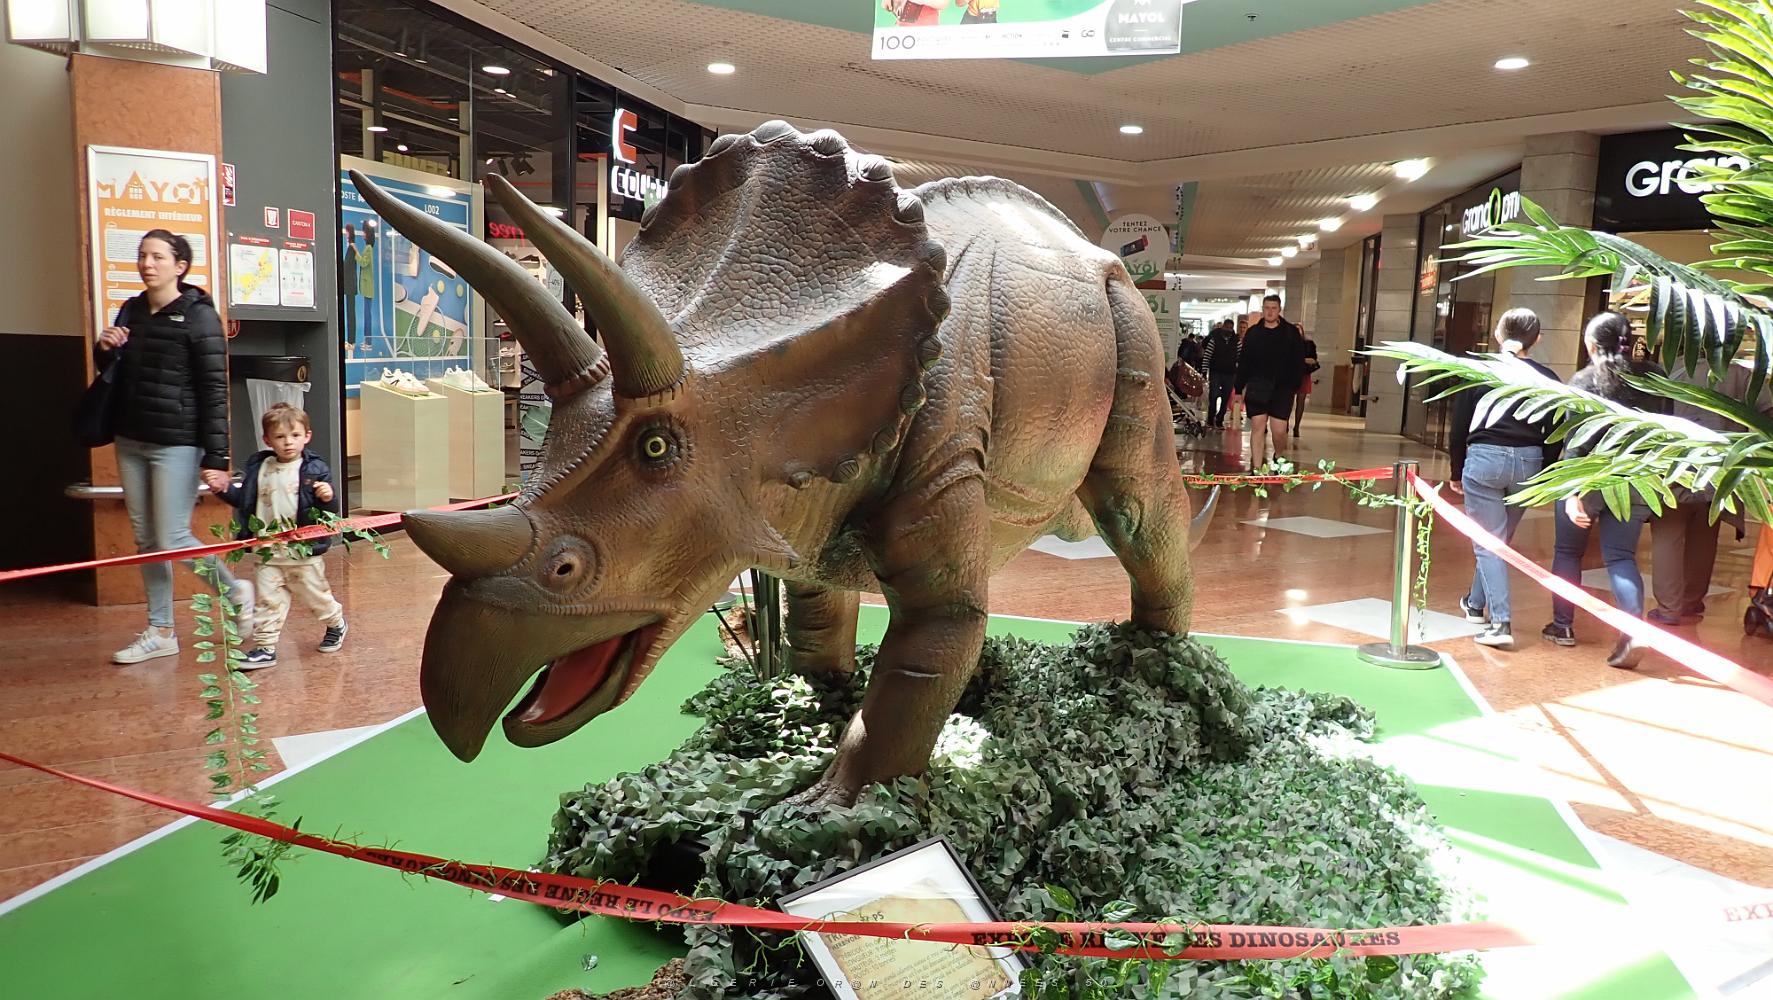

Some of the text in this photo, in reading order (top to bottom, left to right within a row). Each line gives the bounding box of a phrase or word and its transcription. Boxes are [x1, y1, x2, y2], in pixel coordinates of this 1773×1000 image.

[1118, 12, 1165, 24] MAYOL
[104, 206, 156, 219] RÈGLEMENT
[1229, 931, 1400, 948] DINOSAURES
